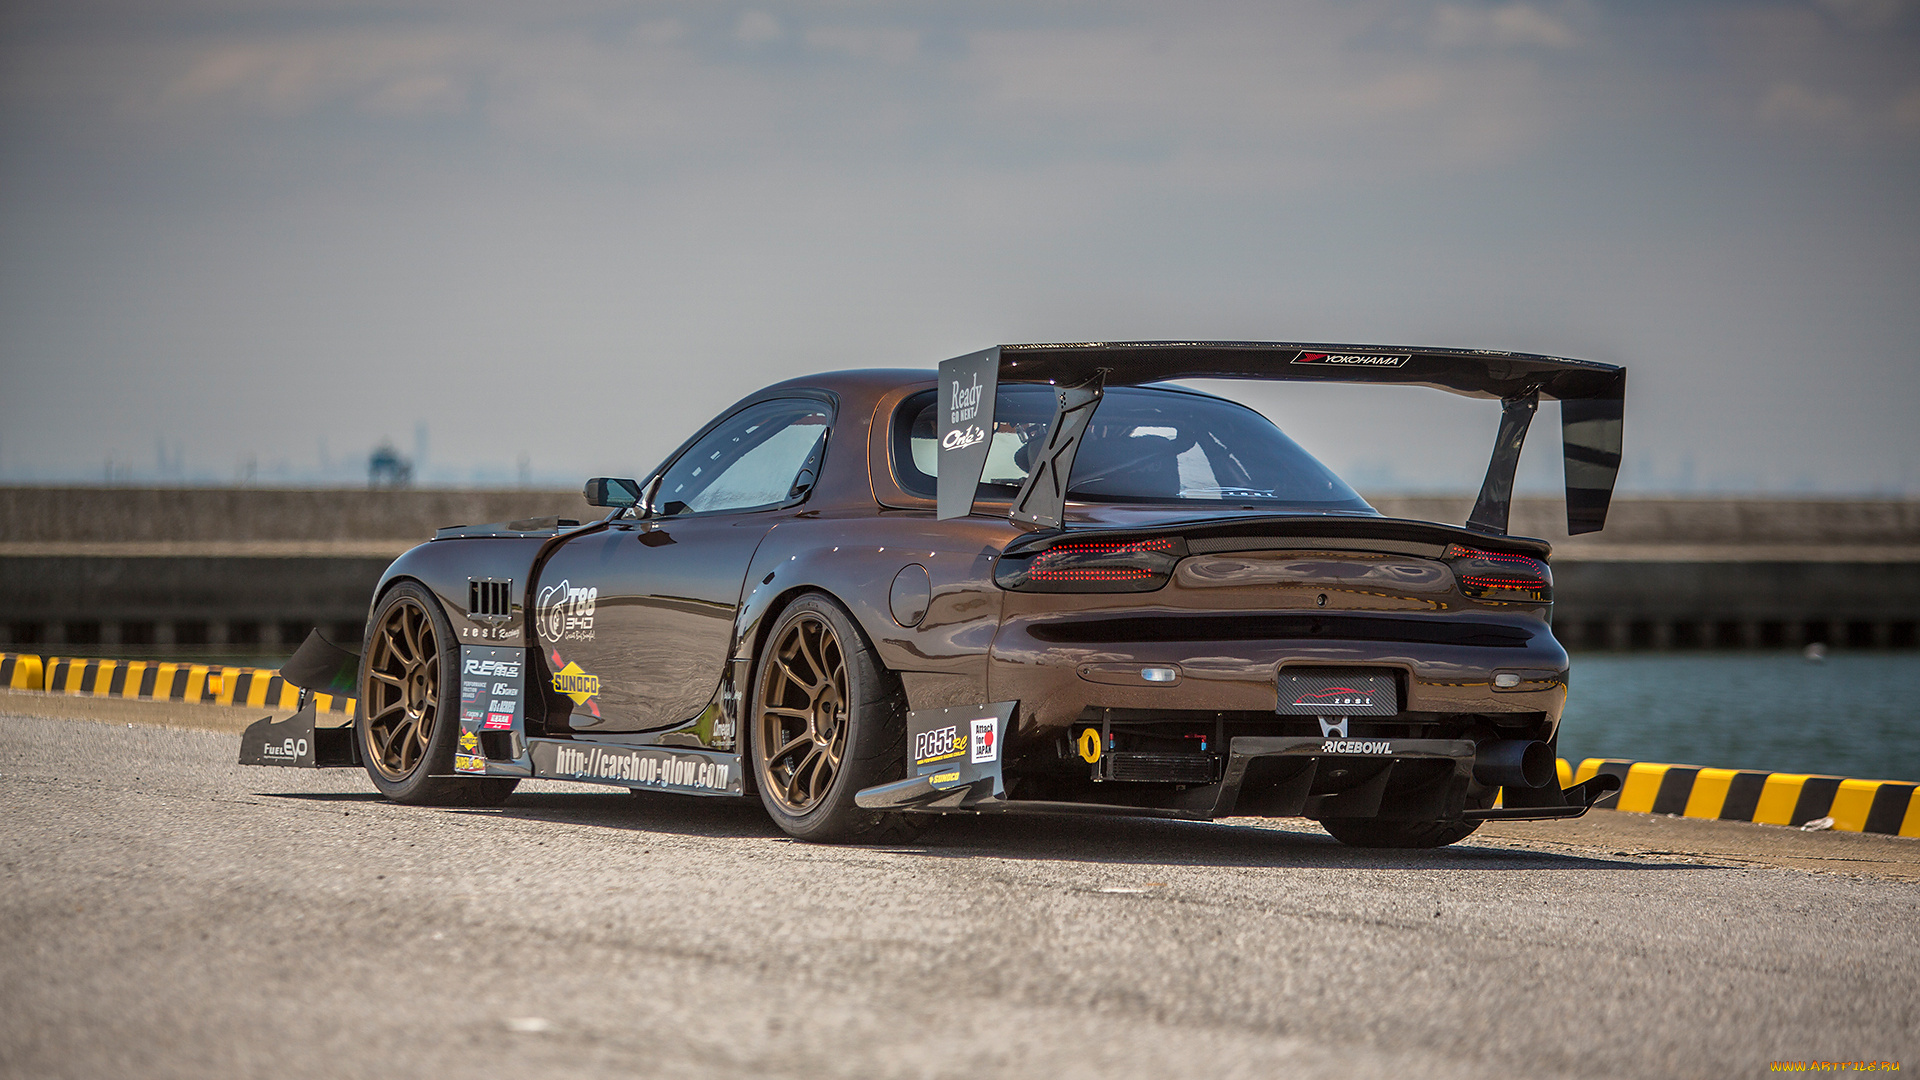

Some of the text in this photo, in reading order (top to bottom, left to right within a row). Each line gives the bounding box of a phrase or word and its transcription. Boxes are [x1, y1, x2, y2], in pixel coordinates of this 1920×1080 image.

[1325, 354, 1399, 366] YOKOHAMA
[950, 372, 983, 417] Ready
[951, 407, 975, 424] GO NEXT
[567, 587, 598, 616] T88
[462, 627, 497, 638] zest
[555, 674, 597, 694] SUNOCO
[976, 723, 994, 734] Attack
[915, 726, 957, 760] PG55
[976, 735, 984, 745] for
[976, 745, 991, 756] JAPAN
[1322, 741, 1393, 754] RICEBOWL
[556, 746, 729, 790] http://carshop-glow.com
[934, 771, 960, 784] SUNOCO
